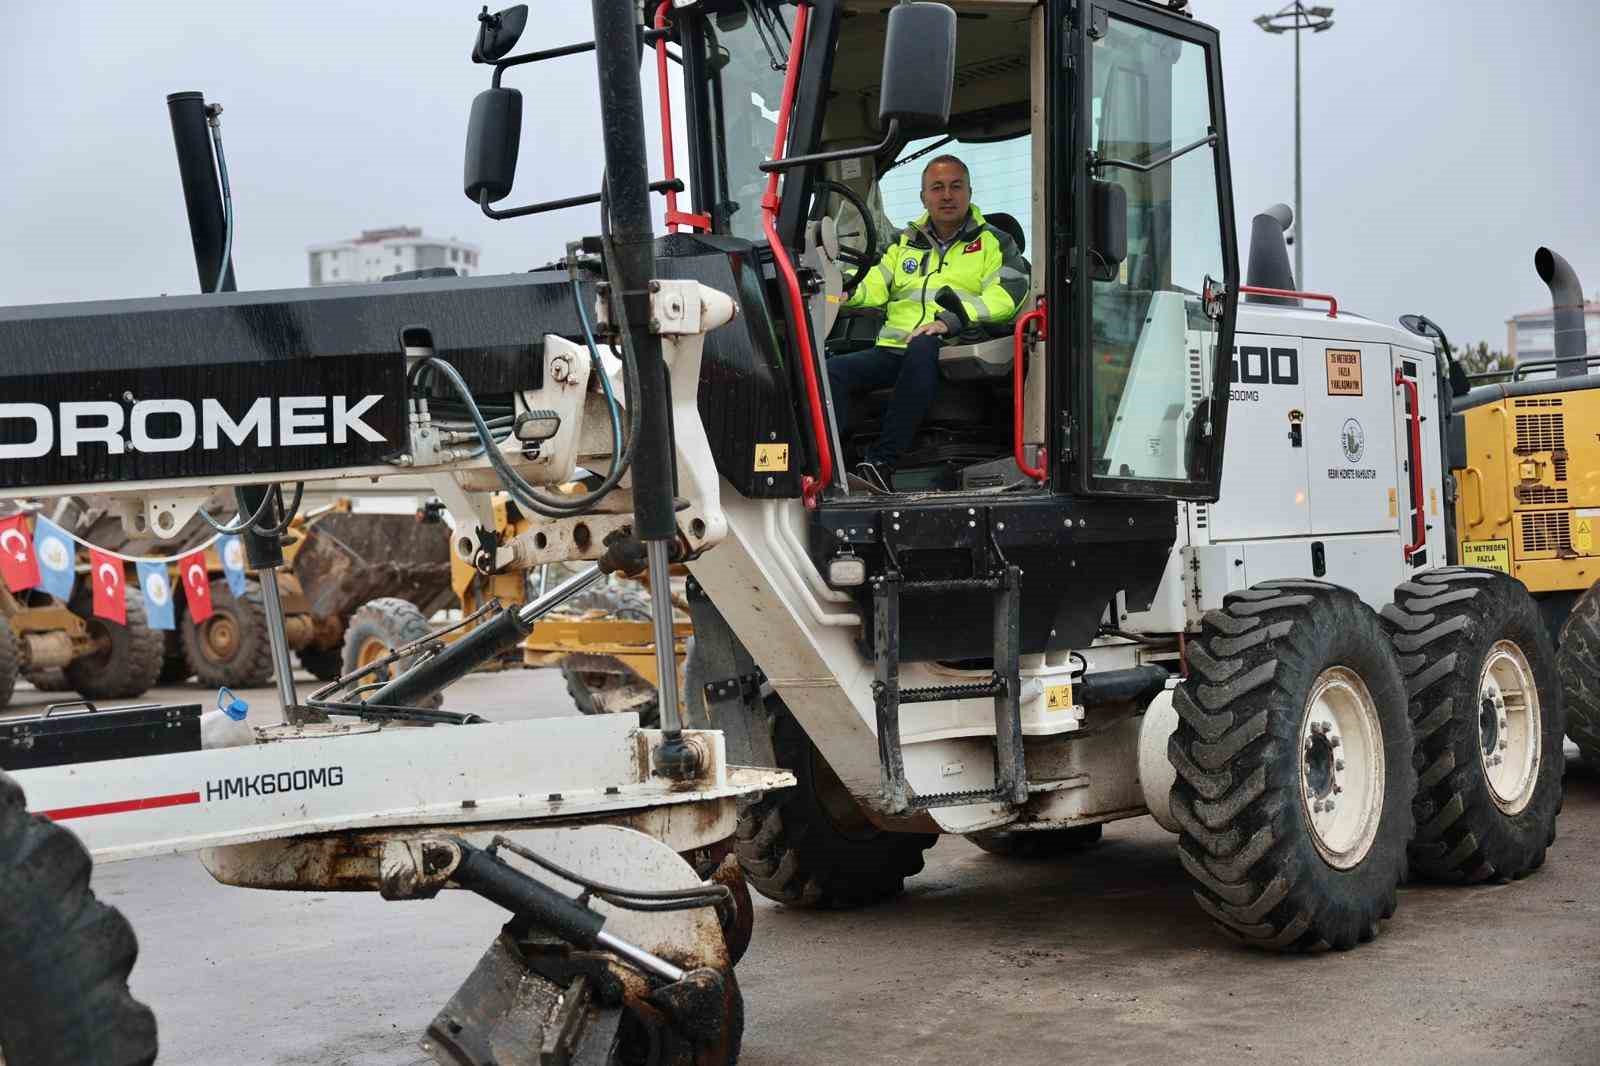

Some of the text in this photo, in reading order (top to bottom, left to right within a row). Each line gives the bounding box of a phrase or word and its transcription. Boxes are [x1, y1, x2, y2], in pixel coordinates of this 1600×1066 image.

[1231, 346, 1299, 385] 00
[0, 394, 388, 459] DROMEK
[1473, 543, 1506, 553] METREDEN
[206, 766, 343, 802] HMK600MG
